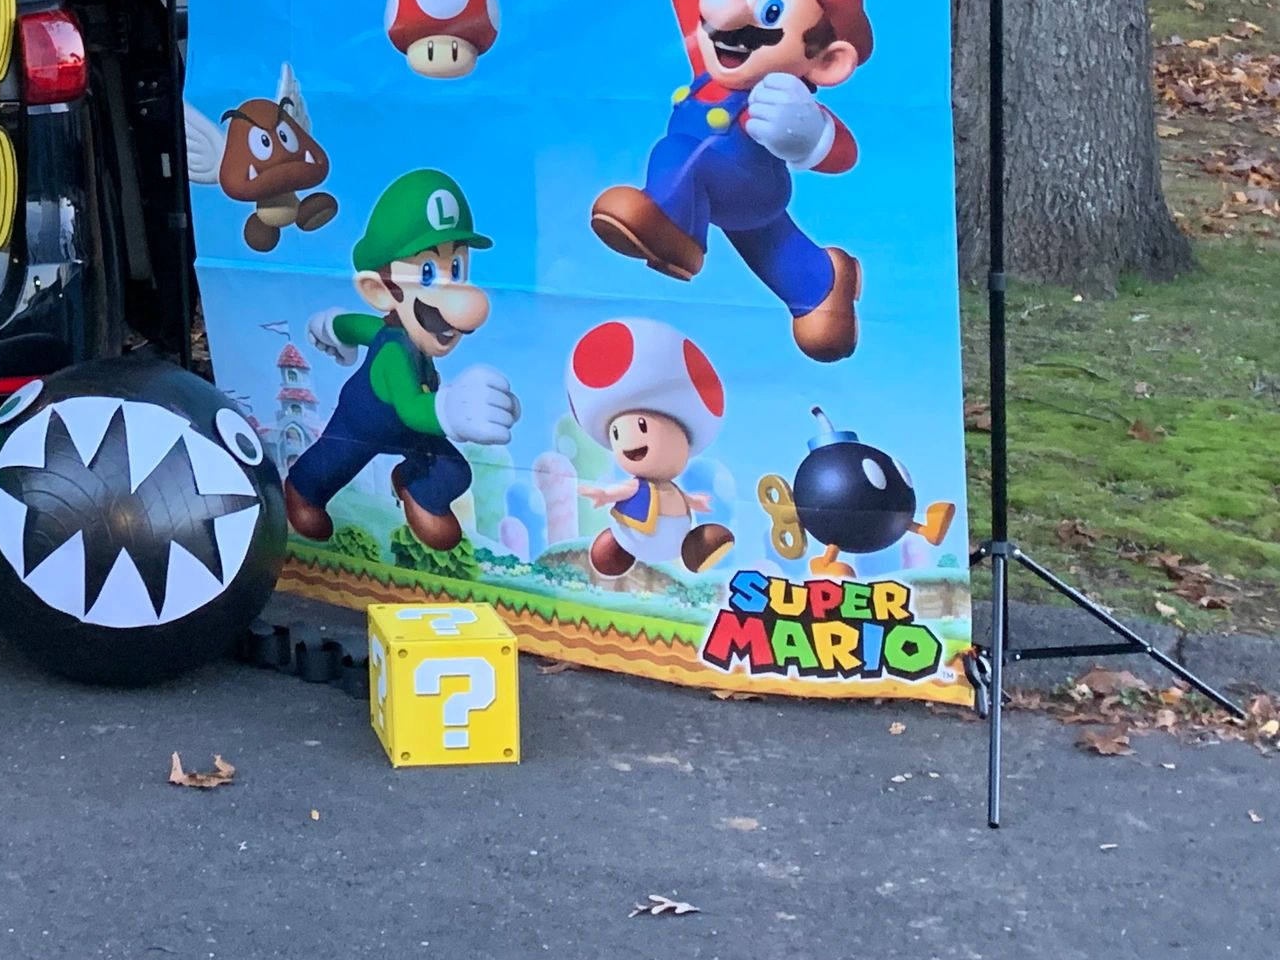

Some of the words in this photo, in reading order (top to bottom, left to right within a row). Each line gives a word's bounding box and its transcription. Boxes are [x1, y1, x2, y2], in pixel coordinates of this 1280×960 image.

[435, 196, 456, 226] L
[729, 570, 913, 622] SUPER
[703, 609, 942, 680] MARIO
